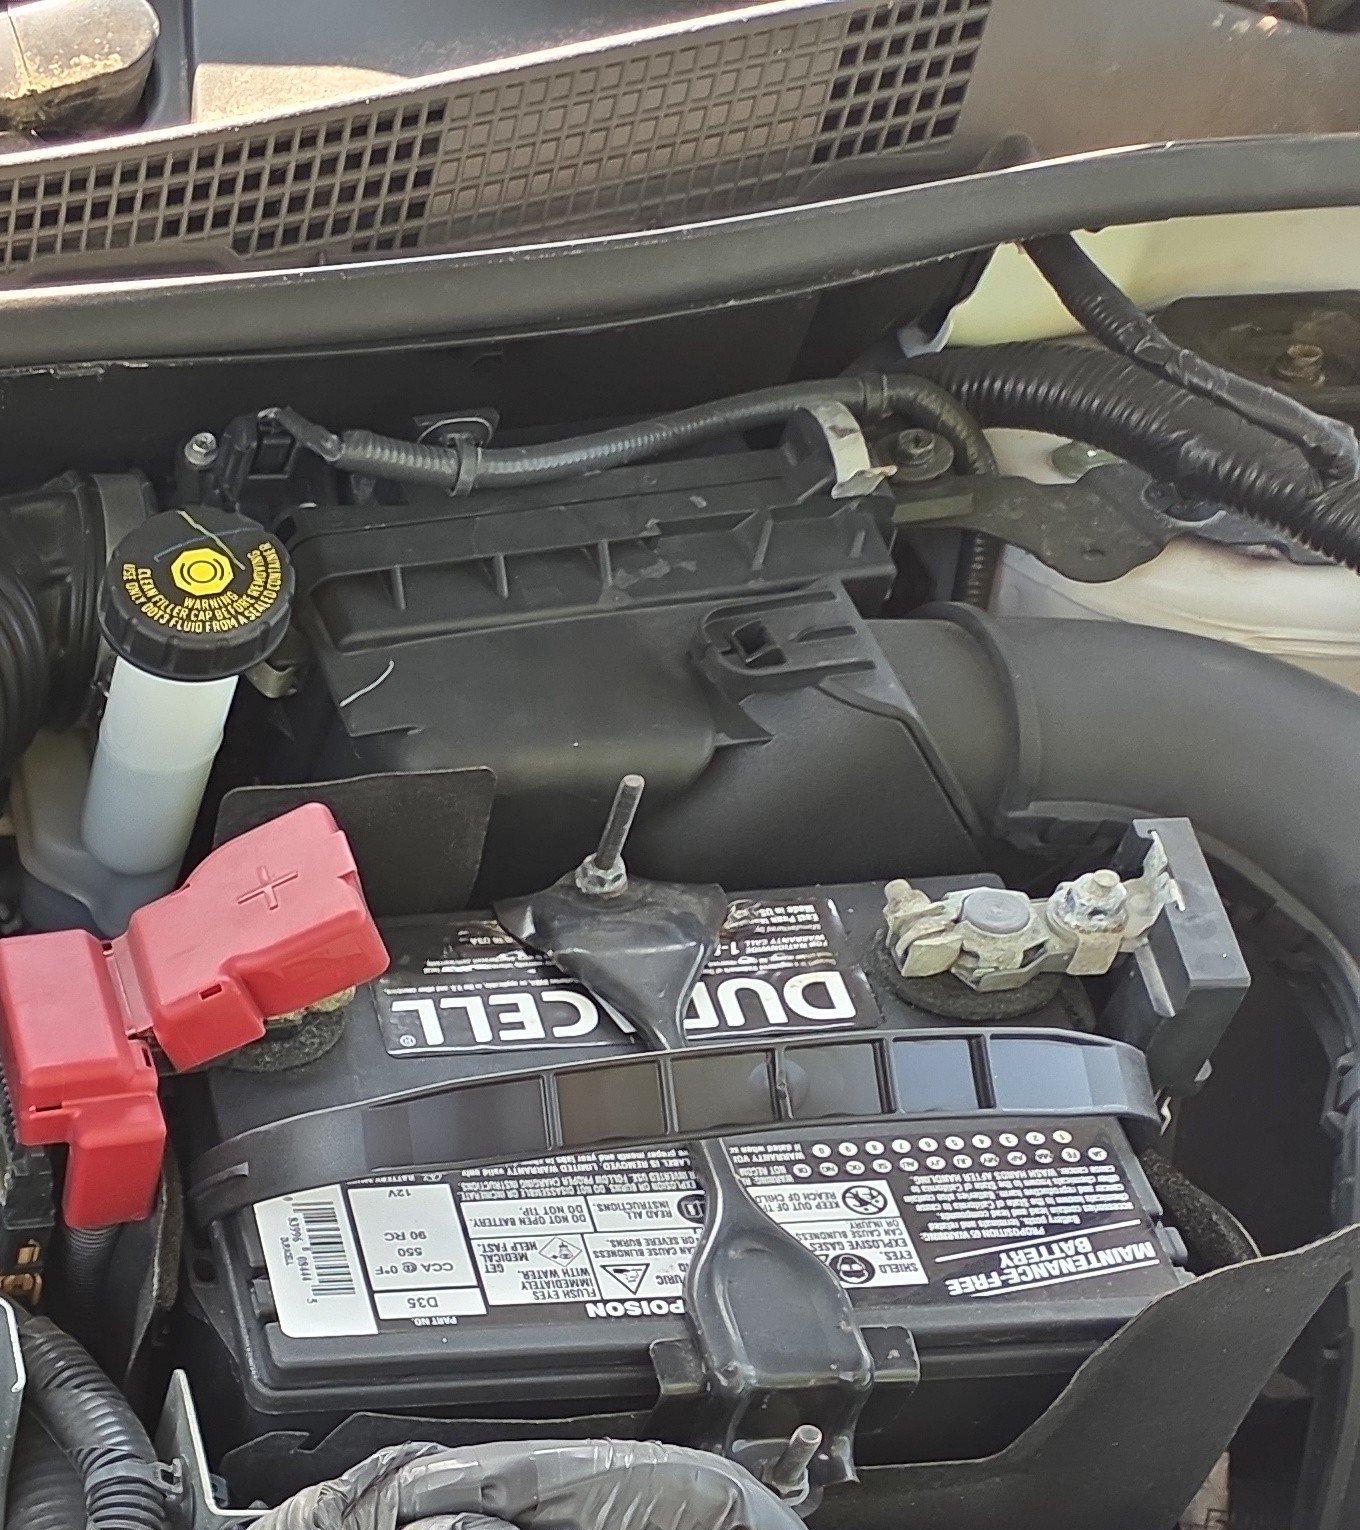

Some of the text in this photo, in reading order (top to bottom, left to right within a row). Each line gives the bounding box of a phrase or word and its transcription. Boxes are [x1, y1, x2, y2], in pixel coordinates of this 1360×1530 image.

[123, 563, 137, 580] USE
[125, 581, 148, 604] ONLY
[138, 568, 159, 597] CLEAN
[151, 595, 189, 619] FILLER
[191, 610, 213, 621] CAP
[214, 594, 256, 620] BEFORE
[184, 591, 238, 611] WARNING
[243, 589, 277, 621] SEALED
[141, 602, 170, 624] DOT3
[168, 617, 203, 633] FLUID
[205, 617, 238, 633] FROM
[237, 614, 249, 626] A
[387, 1189, 411, 1198] 12V
[754, 1192, 837, 1203] REACH OF CHILD
[519, 1205, 583, 1216] DO NOT TIP.
[592, 1201, 668, 1212] INSTRUCTIONS.
[776, 1200, 840, 1212] KEEP OUT OF
[625, 1210, 672, 1219] READ ALL
[469, 1214, 586, 1227] DO NOT OPEN BATTERY.
[885, 1219, 899, 1228] OR
[383, 1231, 427, 1241] 90 RC
[795, 1228, 903, 1241] CAN CAUSE BLINDNESS
[478, 1242, 537, 1253] HELP FAST.
[606, 1236, 695, 1248] OR SEVERE BURNS.
[809, 1238, 908, 1251] EXPLOSIVE GASES
[397, 1247, 422, 1256] 550
[593, 1249, 644, 1258] BLINDNESS
[646, 1247, 677, 1256] CAUSE
[879, 1250, 913, 1260] EYES.
[999, 1236, 1092, 1268] BATTERY
[480, 1253, 529, 1262] MEDICAL
[401, 1262, 417, 1273] @
[420, 1262, 454, 1273] CCA
[485, 1264, 504, 1273] GET
[878, 1262, 918, 1274] SHIELD
[944, 1241, 1156, 1295] MAINTENANCE-FREE
[518, 1268, 590, 1279] WITH WATER.
[521, 1279, 594, 1290] IMMEDIATELY
[655, 1274, 684, 1285] URIC
[533, 1288, 596, 1300] FLUSH EYES
[407, 1297, 438, 1308] D35
[585, 1299, 685, 1318] POISON
[411, 1316, 457, 1326] PART NO.
